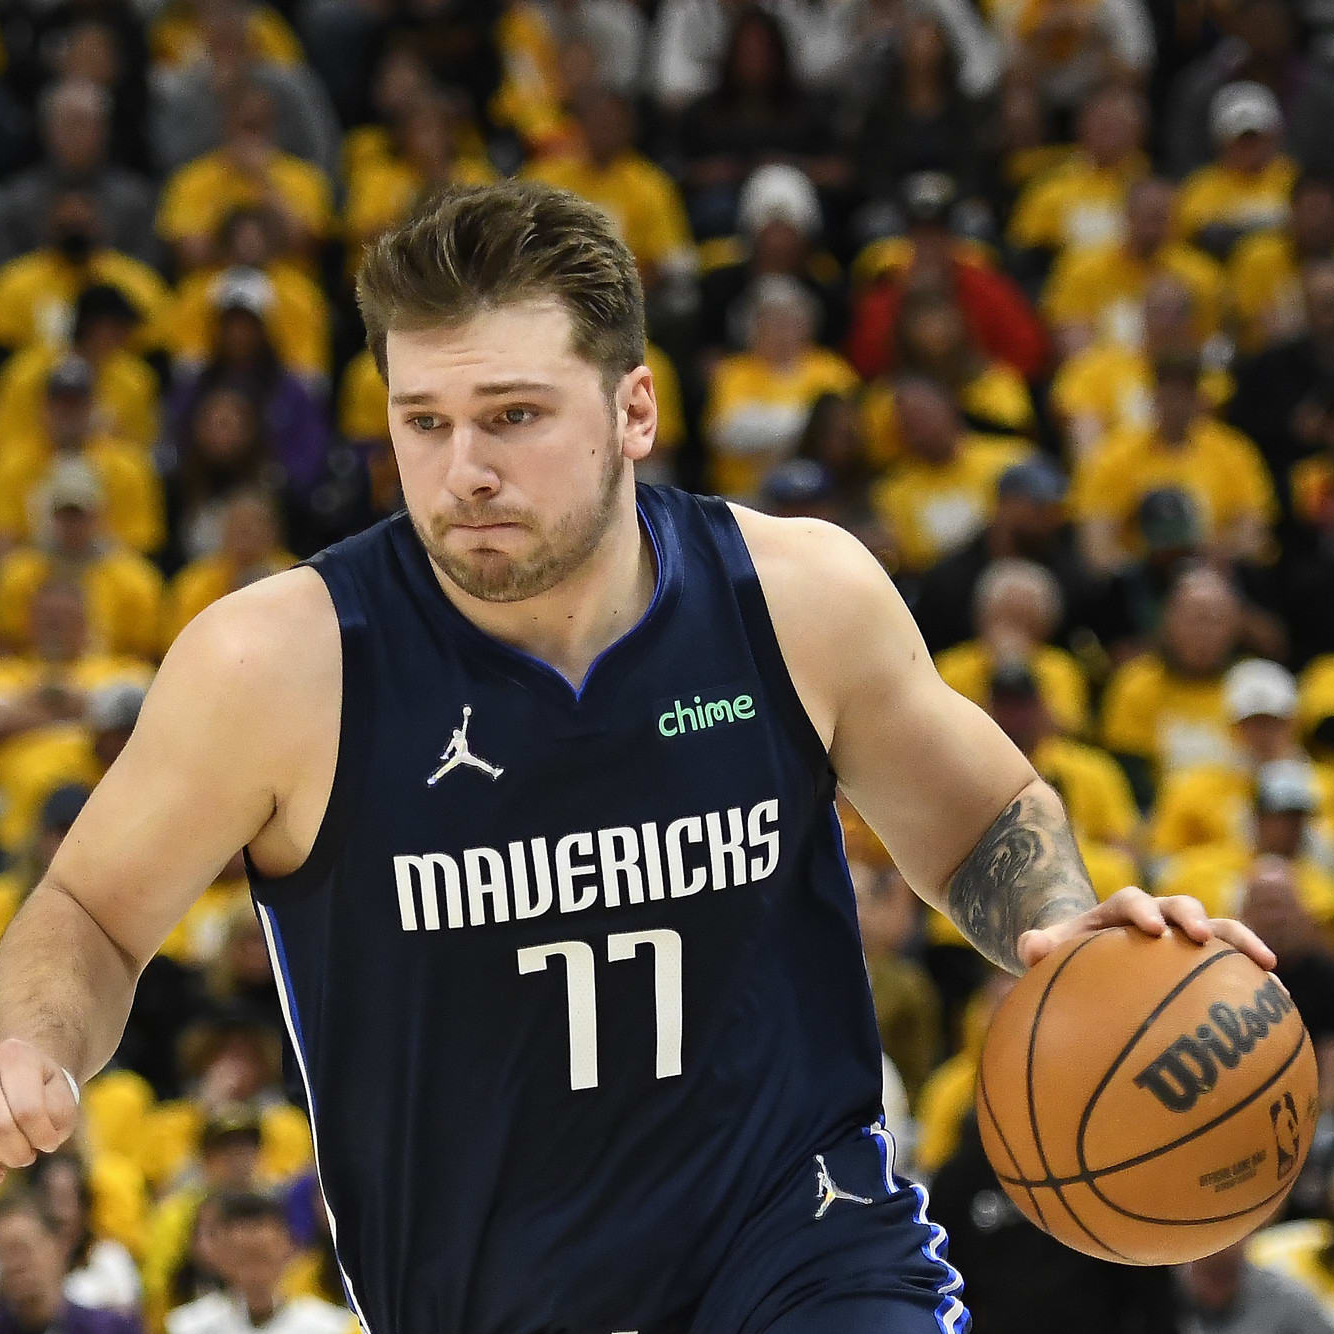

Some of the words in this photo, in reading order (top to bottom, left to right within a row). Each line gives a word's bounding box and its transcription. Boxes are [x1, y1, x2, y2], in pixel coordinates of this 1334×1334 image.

[658, 694, 756, 737] chime
[393, 798, 780, 931] MAVERICKS
[517, 929, 683, 1091] 77
[1133, 978, 1295, 1113] Wilson
